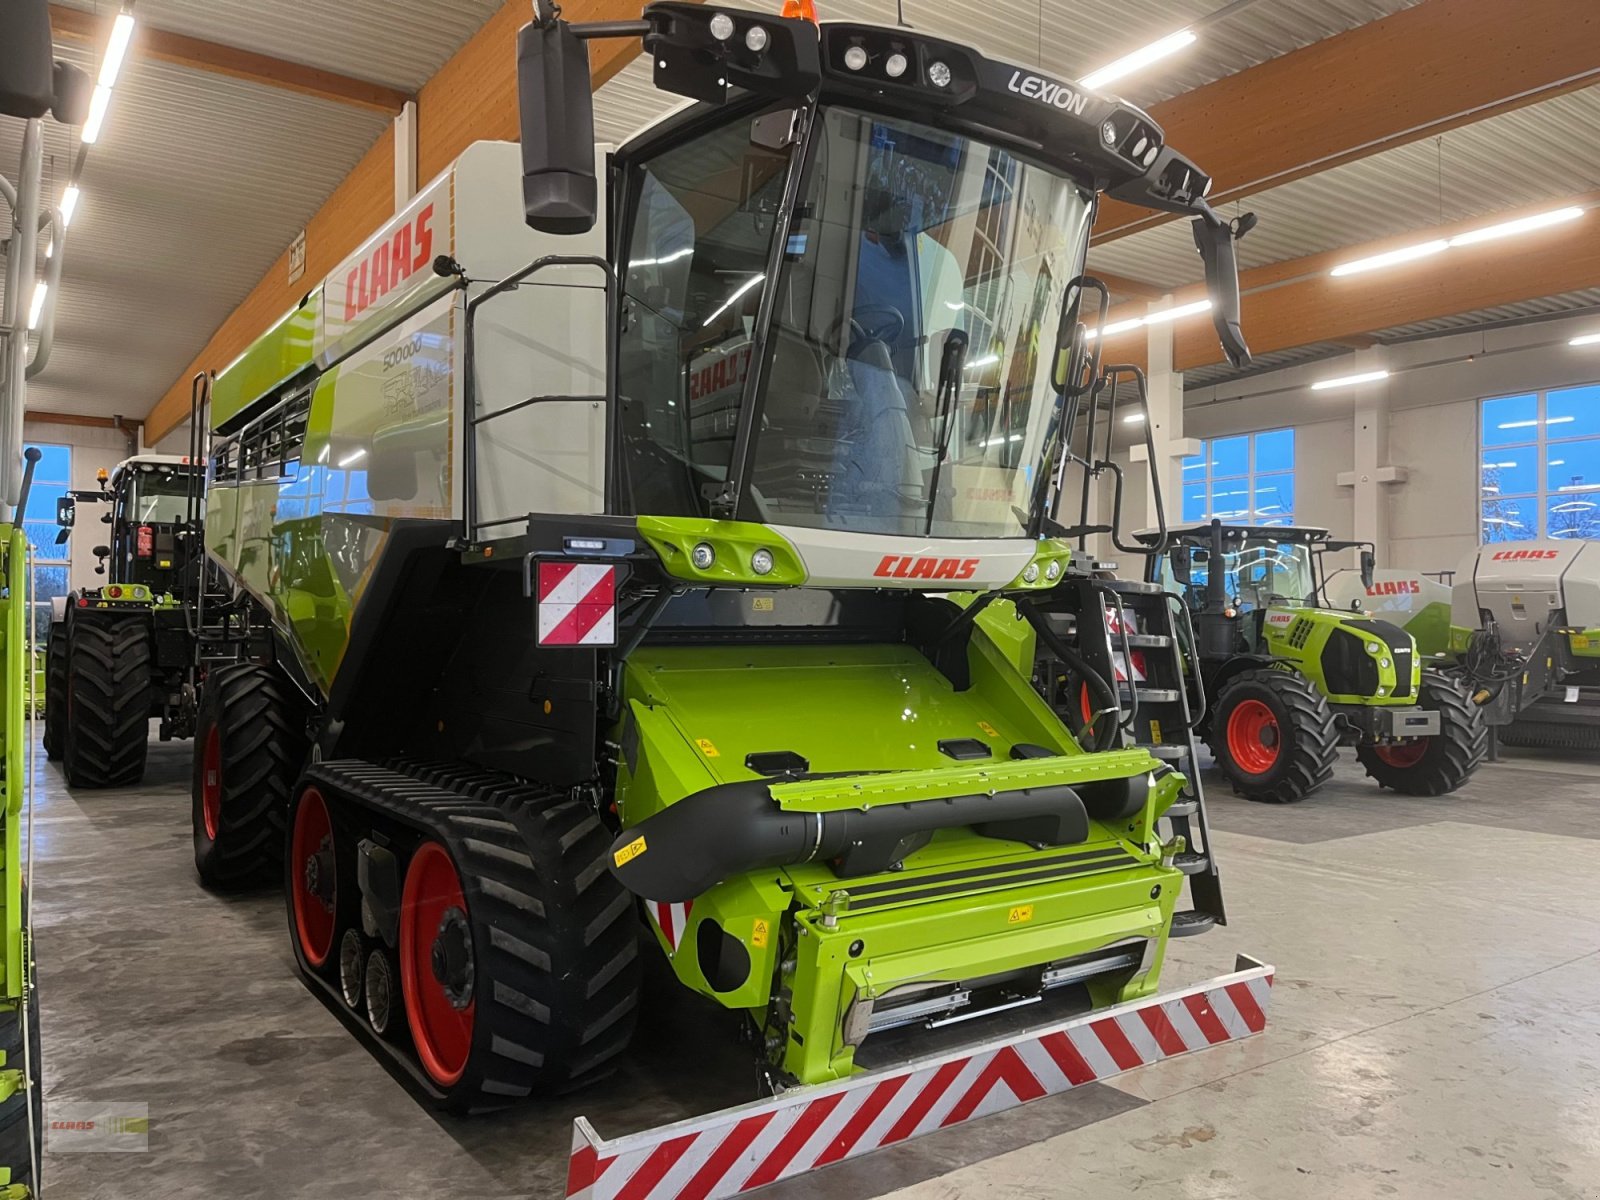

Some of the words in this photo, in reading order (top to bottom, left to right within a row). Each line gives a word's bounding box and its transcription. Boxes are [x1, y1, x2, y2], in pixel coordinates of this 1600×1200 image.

[1007, 70, 1089, 116] LEXION
[344, 202, 434, 323] CLAAS
[873, 555, 980, 580] CLAAS
[1492, 550, 1559, 561] CLAAS
[1366, 580, 1420, 596] CLAAS
